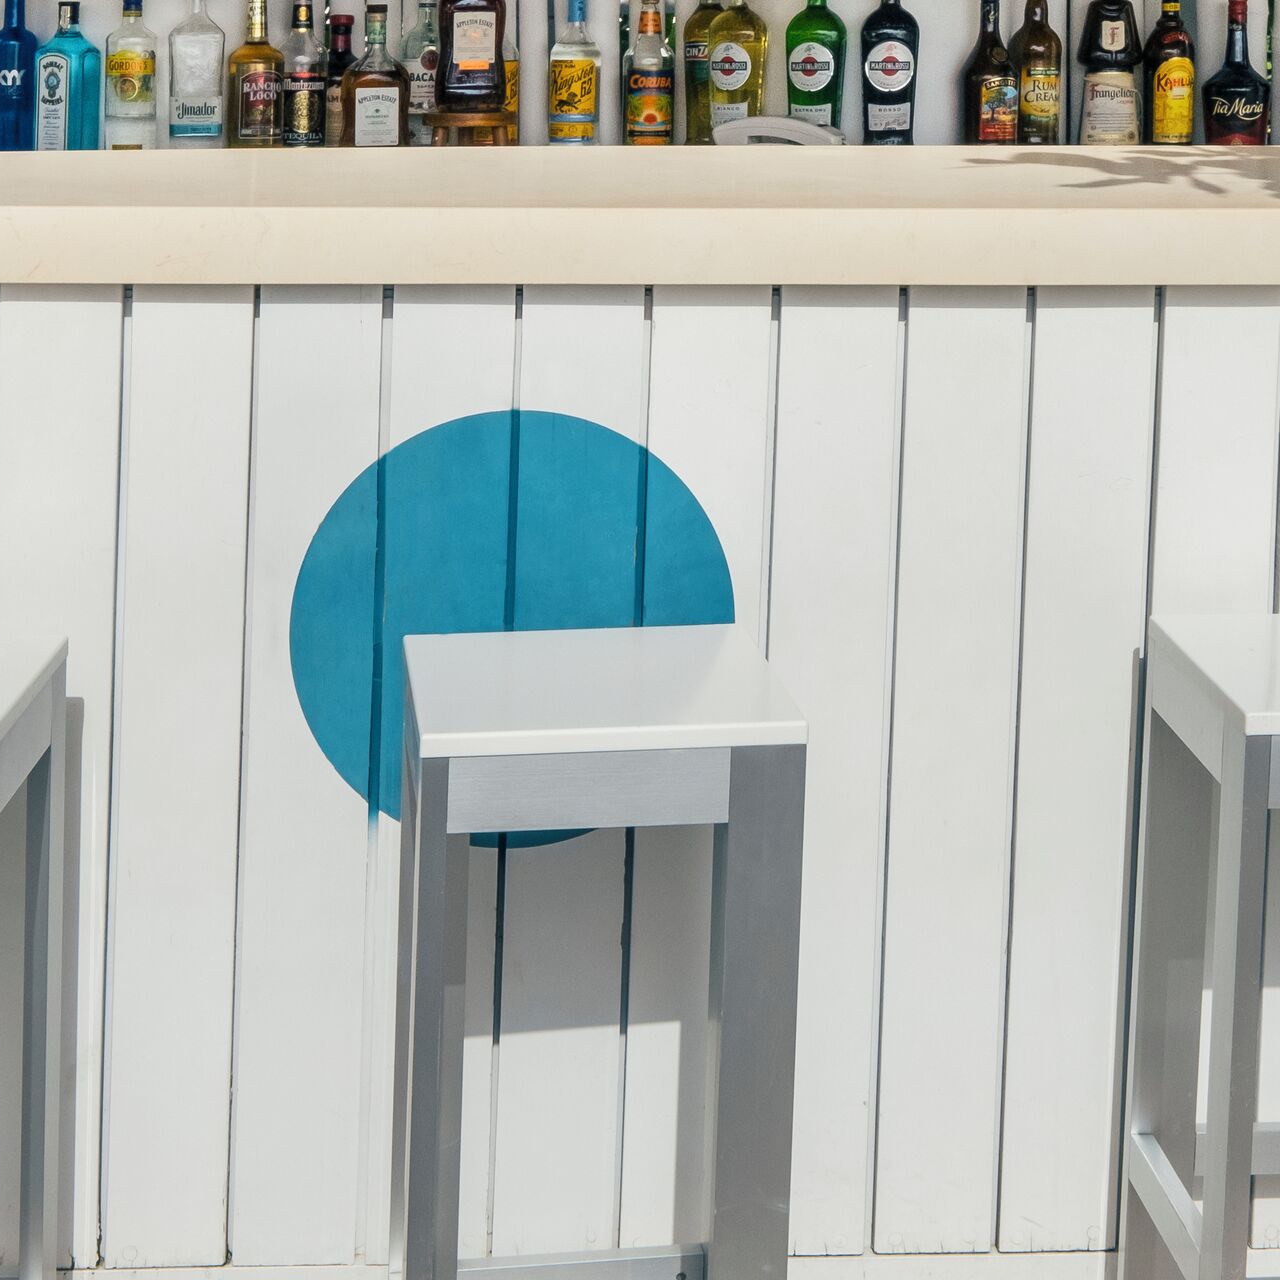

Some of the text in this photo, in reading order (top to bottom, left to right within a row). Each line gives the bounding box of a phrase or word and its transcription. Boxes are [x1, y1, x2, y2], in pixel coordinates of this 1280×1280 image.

[456, 19, 494, 29] APPLETON ESTATE
[686, 45, 708, 59] CINZ
[409, 73, 435, 81] BACA
[552, 66, 593, 95] Kingston
[629, 74, 671, 88] CORUBA
[243, 81, 282, 93] RANCHO
[283, 79, 325, 90] Montezuma
[580, 77, 592, 98] 62
[1032, 80, 1057, 92] RUM
[250, 90, 277, 101] LOCO
[1089, 83, 1136, 101] Frangelico
[358, 94, 380, 104] APPLETON
[177, 102, 218, 120] Jimador
[1211, 97, 1264, 118] Tia Maria
[283, 132, 323, 141] TEQUILA
